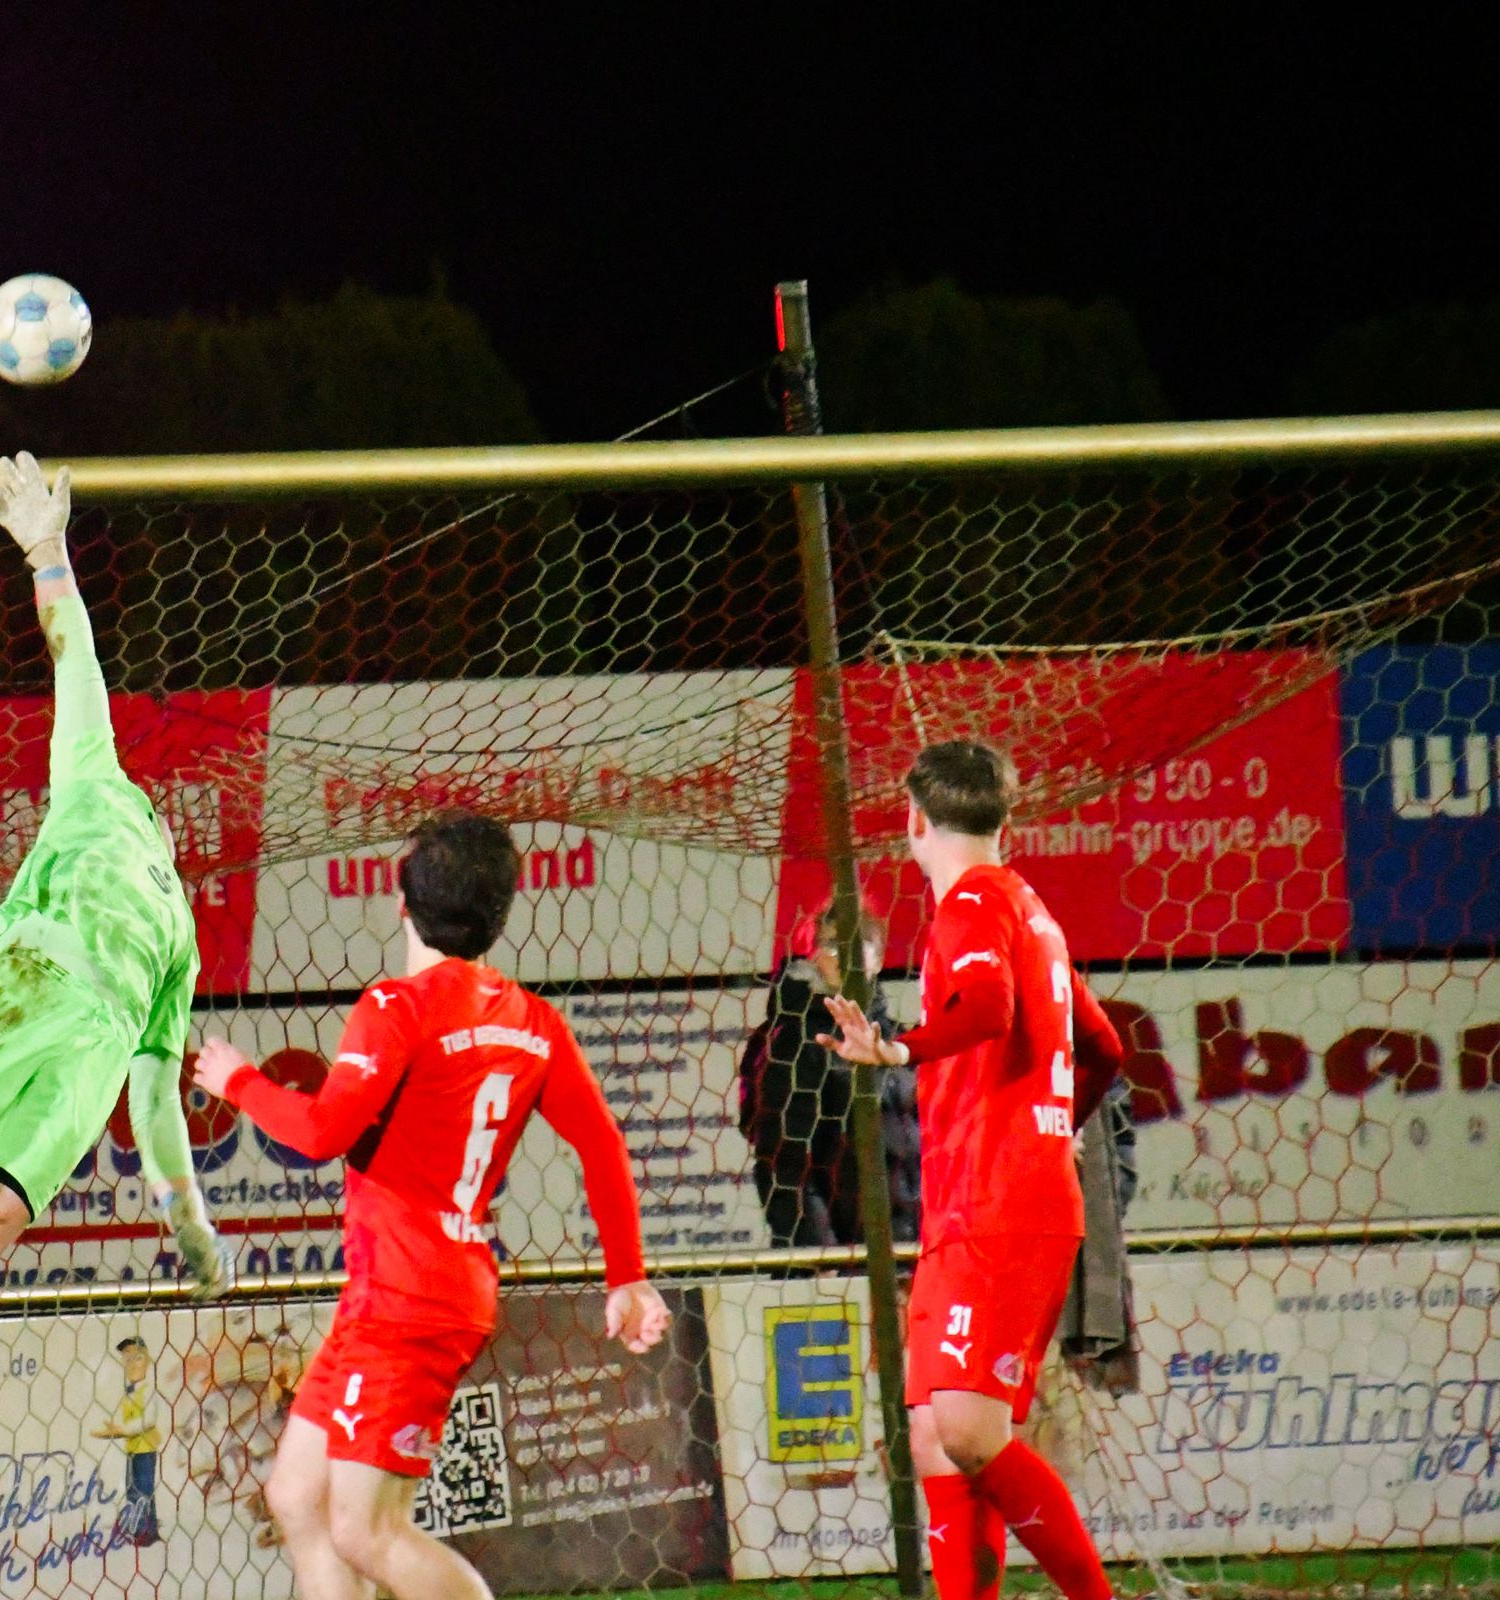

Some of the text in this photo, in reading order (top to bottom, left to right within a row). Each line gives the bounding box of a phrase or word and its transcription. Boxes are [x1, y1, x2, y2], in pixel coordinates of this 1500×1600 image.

[453, 1072, 515, 1215] 6
[946, 1304, 972, 1337] 31
[1168, 1350, 1280, 1377] Edeka
[778, 1427, 856, 1448] EDEKA
